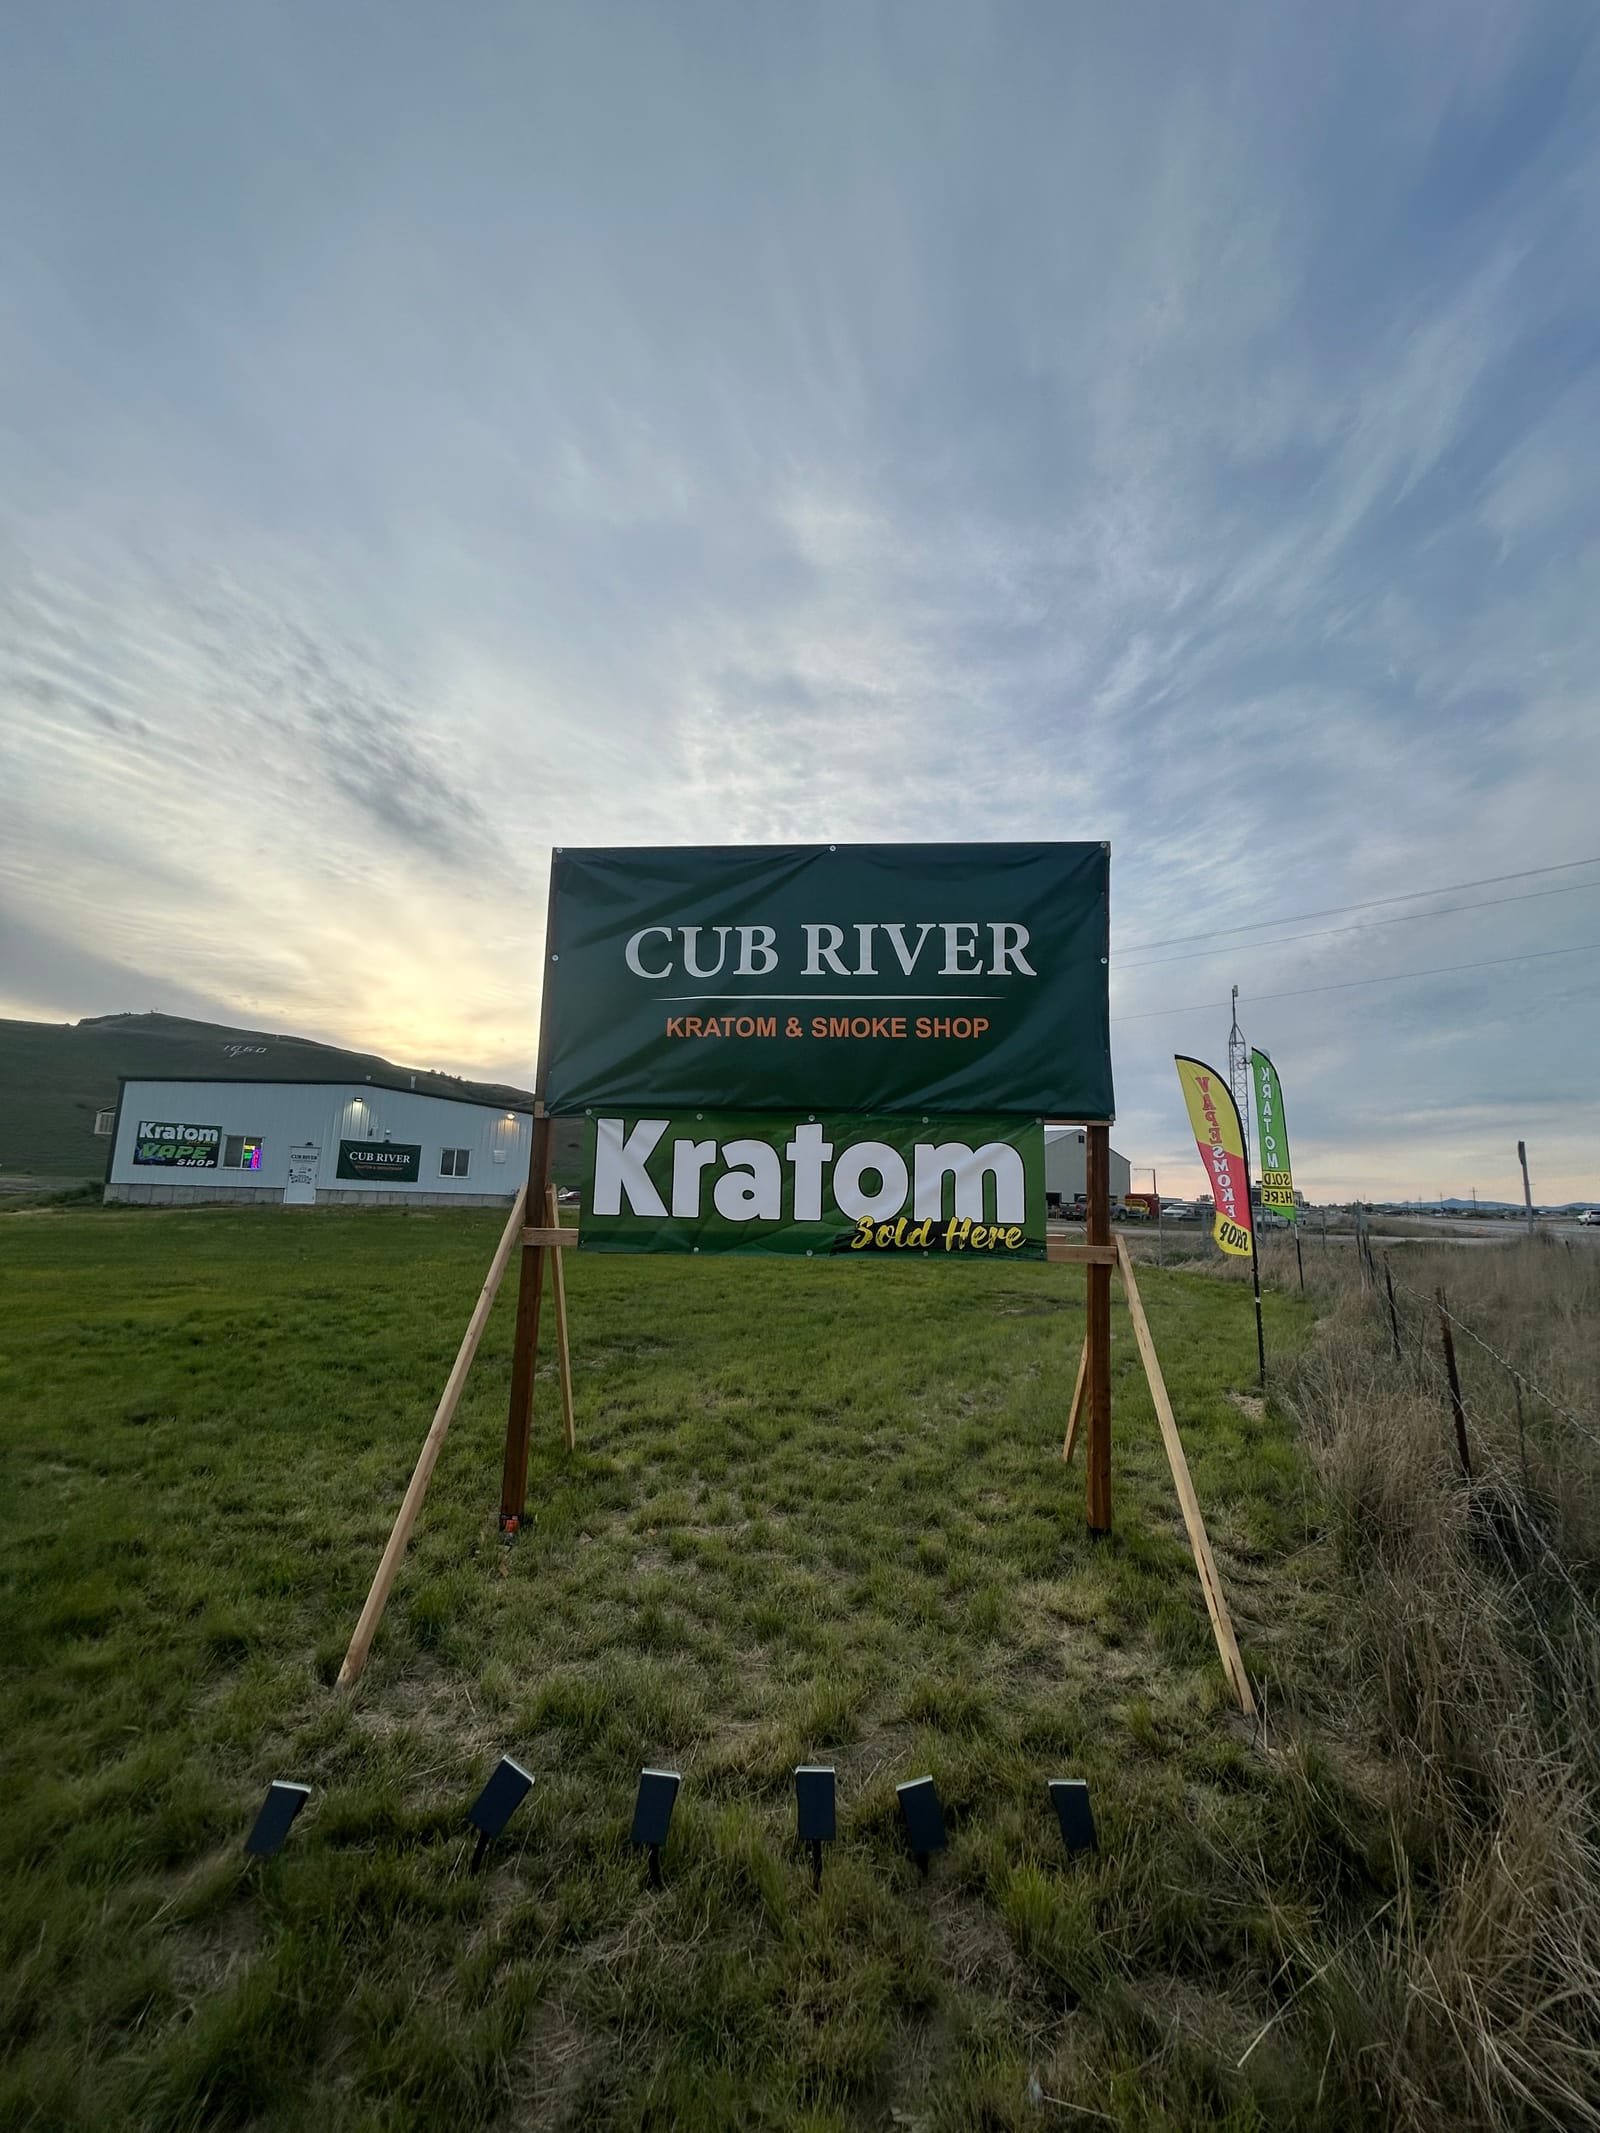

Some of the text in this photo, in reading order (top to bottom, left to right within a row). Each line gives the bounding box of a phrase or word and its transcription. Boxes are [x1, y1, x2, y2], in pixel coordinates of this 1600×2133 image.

[625, 922, 1037, 979] CUB RIVER
[666, 1017, 989, 1039] KRATOM & SMOKE SHOP
[139, 1122, 218, 1142] Kratom
[142, 1143, 211, 1159] VAPE
[349, 1151, 410, 1164] CUB RIVER
[176, 1159, 215, 1167] SHOP
[592, 1117, 1026, 1224] Kratom
[851, 1215, 1026, 1252] Sold Here
